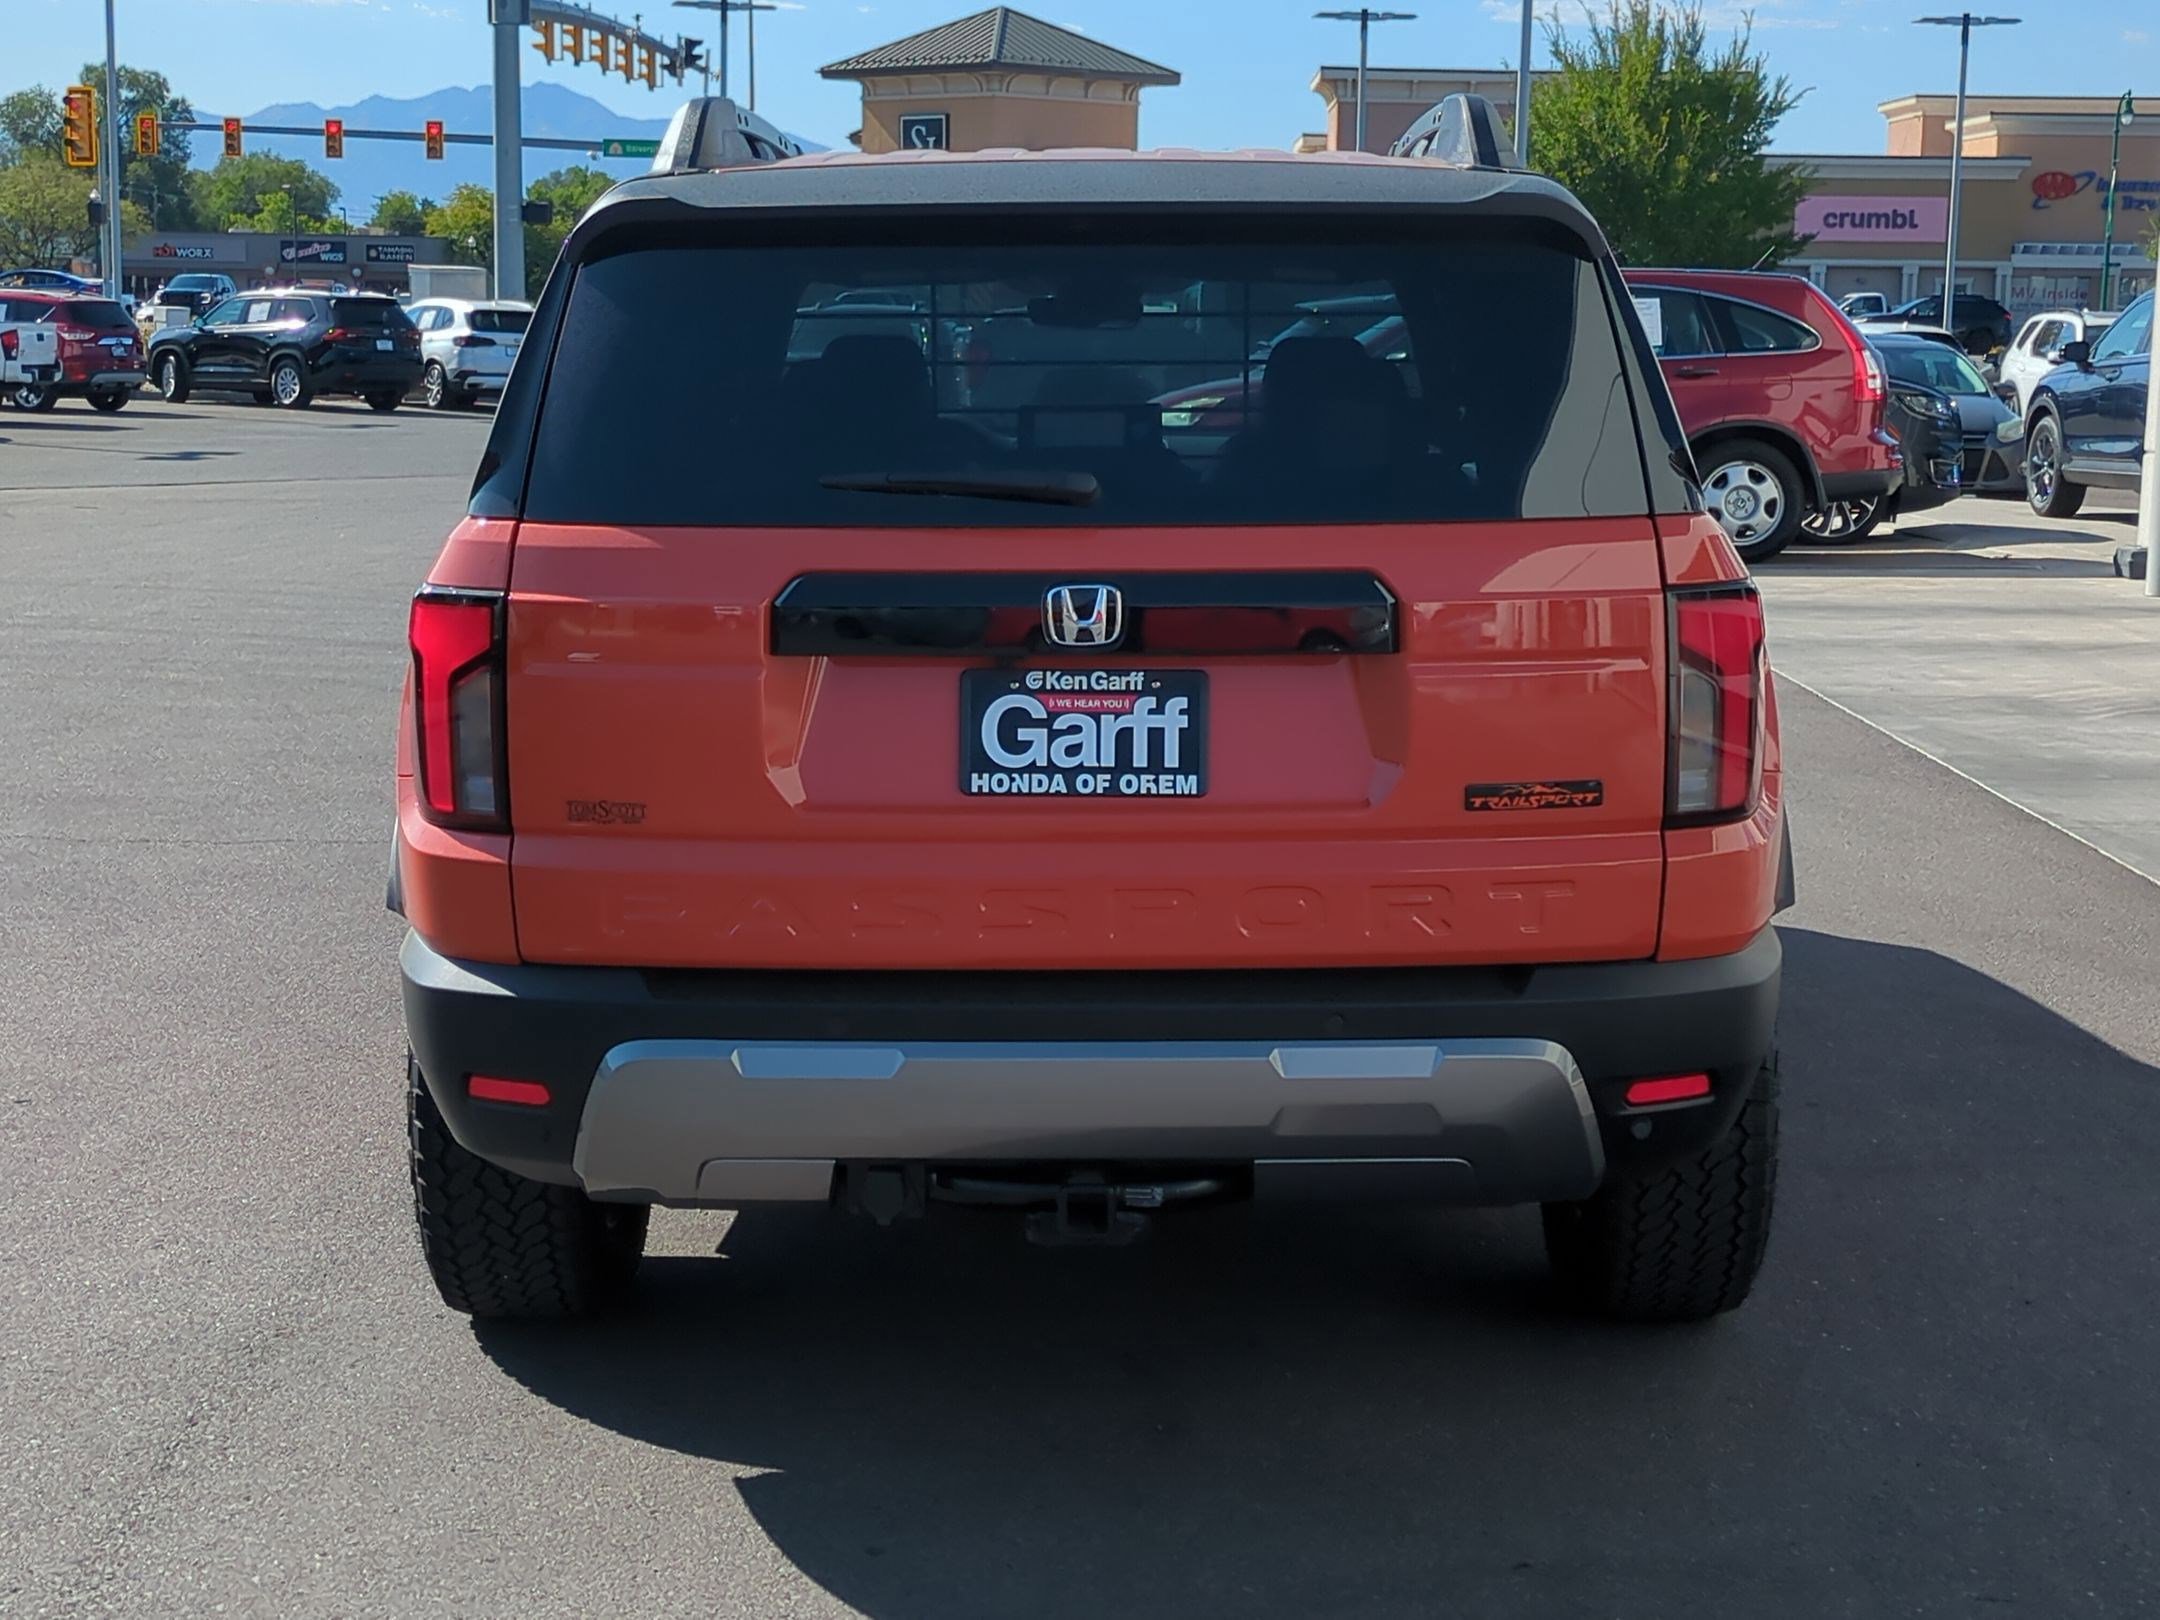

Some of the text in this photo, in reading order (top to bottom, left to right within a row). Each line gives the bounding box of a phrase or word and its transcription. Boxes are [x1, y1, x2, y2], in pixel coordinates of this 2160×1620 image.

[1822, 208, 1919, 229] crumbl
[153, 246, 213, 258] HOTWORX
[1045, 671, 1145, 691] Ken Garff
[1057, 700, 1122, 708] WE HEAR YOU
[980, 693, 1189, 769] Garff
[971, 772, 1198, 795] HONDA OF OREM
[1469, 792, 1600, 810] TRAILSPORT
[602, 880, 1578, 938] PASSPORT
